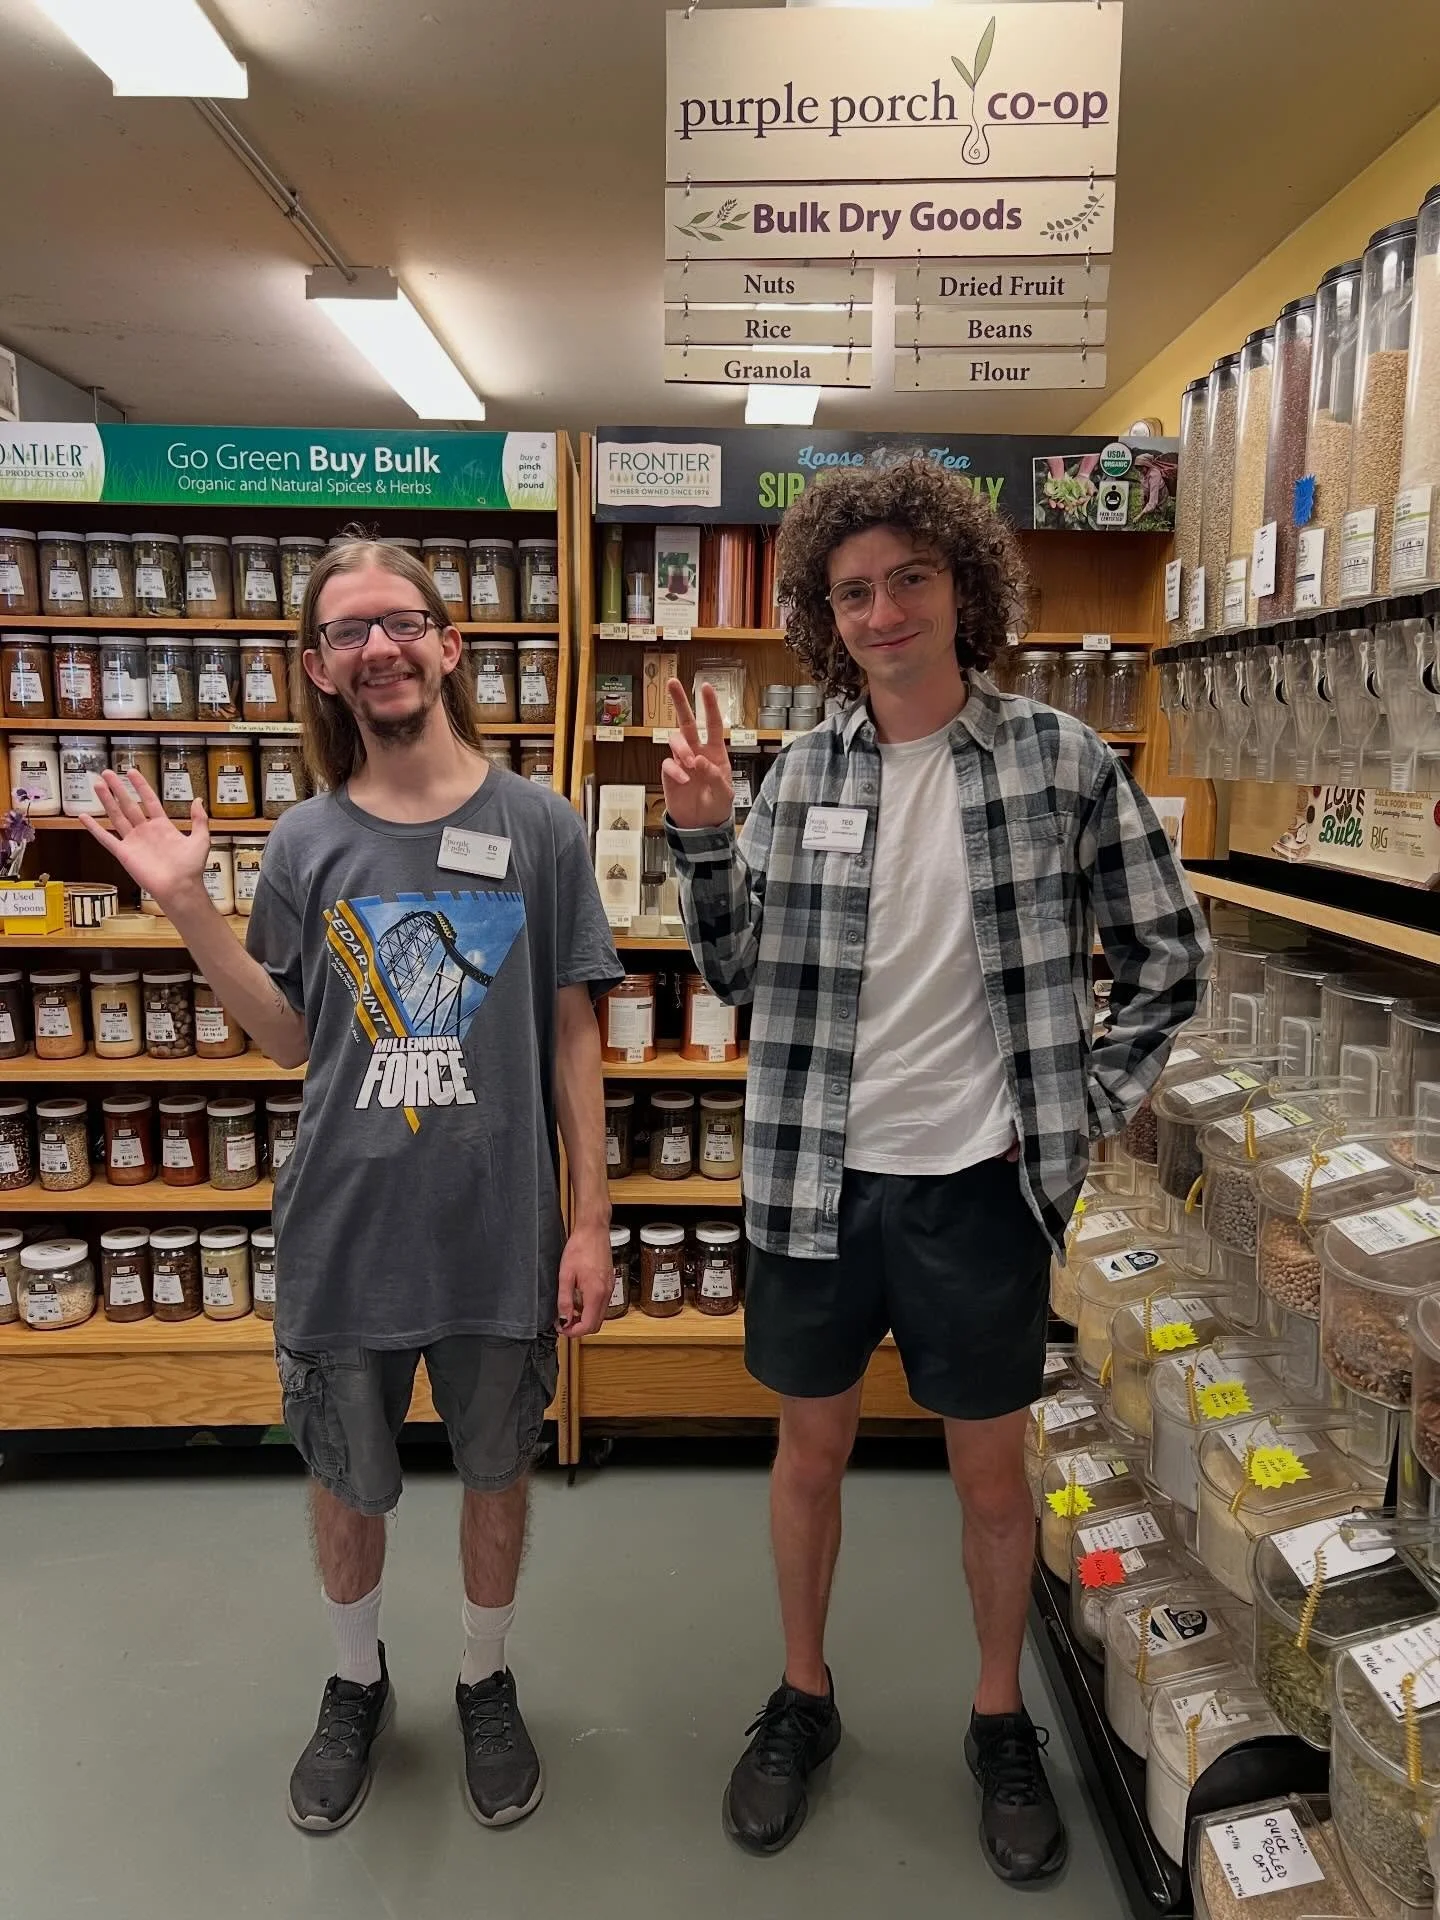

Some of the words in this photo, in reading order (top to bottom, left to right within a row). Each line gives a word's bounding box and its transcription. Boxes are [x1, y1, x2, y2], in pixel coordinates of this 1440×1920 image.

[680, 81, 819, 139] purple
[829, 79, 958, 137] porch
[987, 90, 1108, 128] co-op
[753, 202, 831, 234] Bulk
[840, 202, 901, 240] Dry
[910, 199, 1022, 232] Goods
[744, 274, 795, 294] Nuts
[939, 276, 1003, 297] Dried
[1009, 275, 1065, 297] Fruit
[745, 320, 791, 338] Rice
[968, 320, 1033, 339] Beans
[724, 360, 811, 380] Granola
[970, 362, 1030, 382] Flour
[168, 442, 208, 469] Go
[216, 444, 300, 471] Green
[310, 445, 367, 478] Buy
[375, 447, 440, 473] Bulk
[518, 463, 542, 472] pinch
[520, 454, 532, 462] buy
[609, 453, 710, 472] FRONTIER
[798, 446, 865, 470] Loose
[928, 447, 971, 469] Tea
[178, 476, 235, 494] Organic
[240, 477, 267, 492] and
[271, 477, 323, 493] Natural
[327, 479, 372, 495] Spices
[376, 481, 386, 494] &
[390, 480, 432, 494] Herbs
[518, 481, 544, 490] pound
[636, 472, 684, 484] CO-OP
[1319, 814, 1364, 848] Bulk
[14, 892, 34, 900] Used
[14, 904, 44, 914] Spoons
[373, 1035, 461, 1054] MILLENNIUM
[354, 1050, 477, 1110] FORCE
[1264, 1818, 1290, 1854] QUICK
[1262, 1838, 1288, 1878] ROLLED
[1252, 1854, 1274, 1883] OATS
